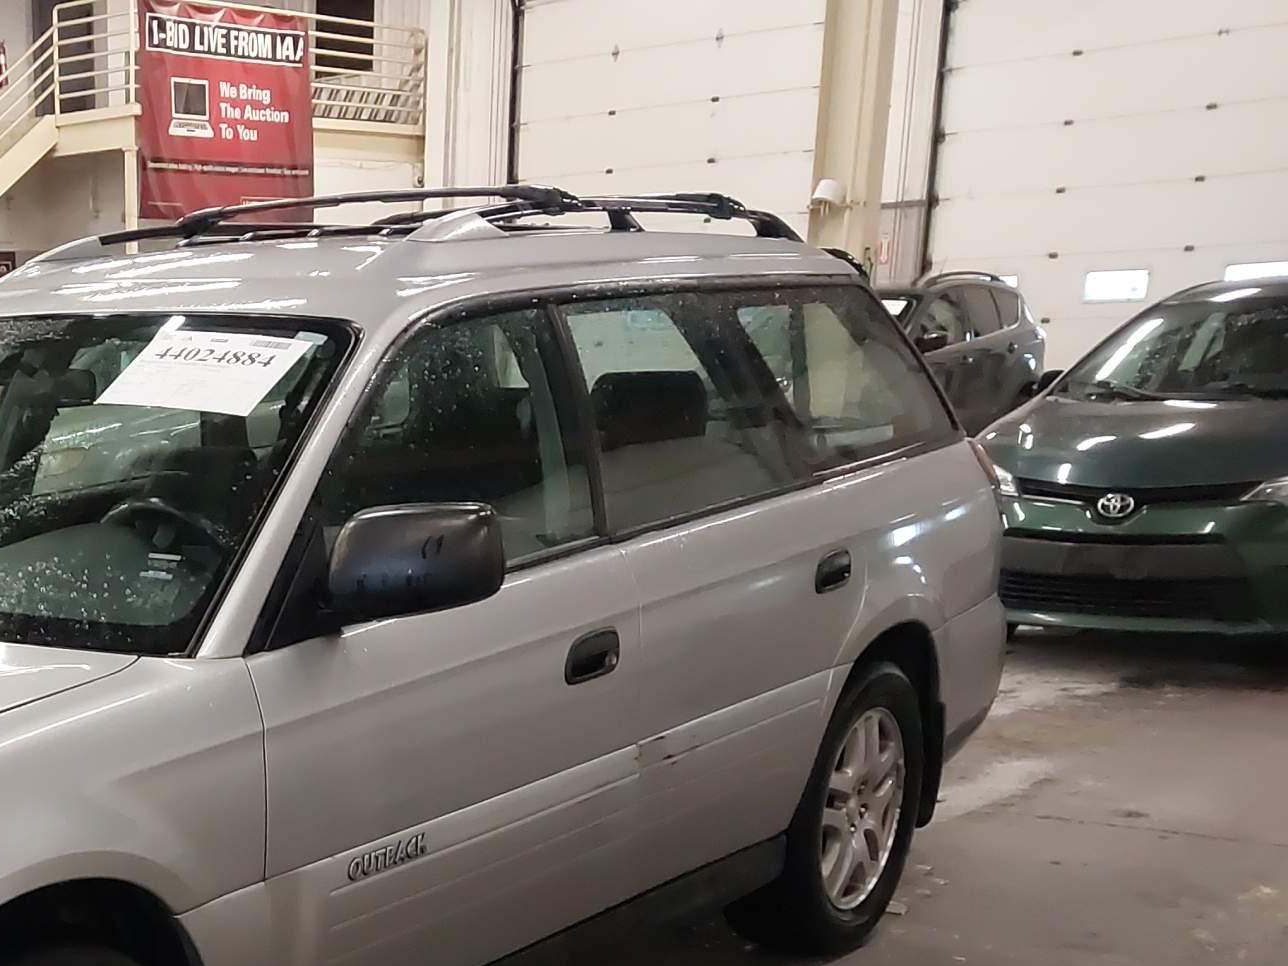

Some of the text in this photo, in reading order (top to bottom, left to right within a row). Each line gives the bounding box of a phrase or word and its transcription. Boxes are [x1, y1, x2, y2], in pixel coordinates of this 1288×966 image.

[151, 19, 190, 50] I-BID
[194, 25, 227, 54] LIVE
[229, 30, 272, 60] FROM
[219, 81, 271, 104] We Bring
[219, 103, 290, 123] The Auction
[219, 124, 259, 141] To You
[154, 346, 279, 368] 44024884
[347, 832, 428, 881] OUTBACK
